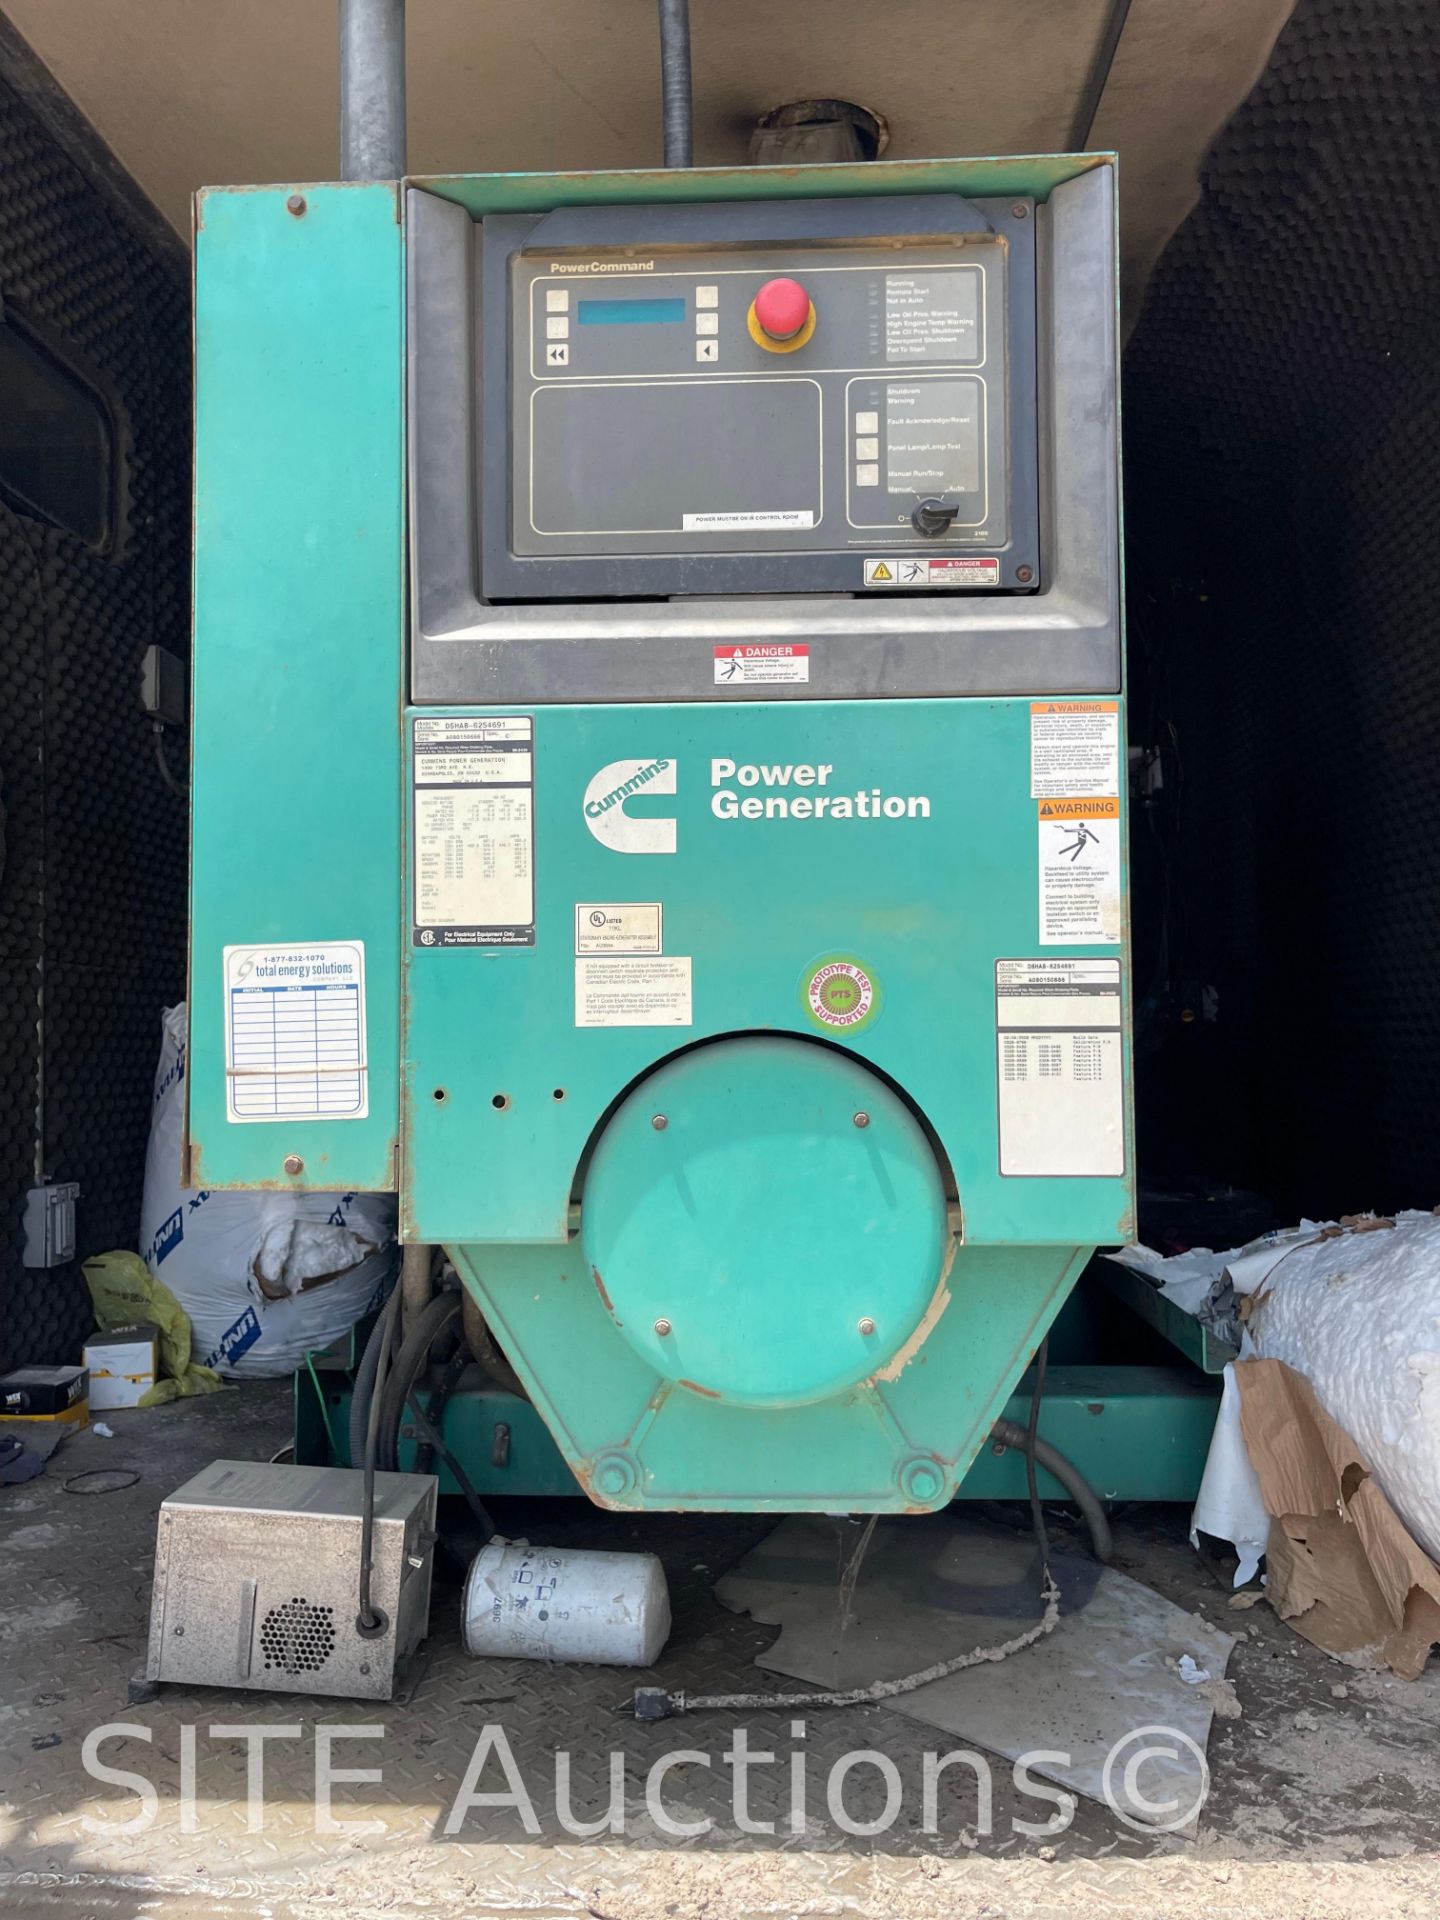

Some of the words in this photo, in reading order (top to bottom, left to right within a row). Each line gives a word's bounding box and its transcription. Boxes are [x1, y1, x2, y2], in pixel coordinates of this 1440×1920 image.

[551, 261, 654, 272] PowerCommand
[746, 647, 792, 656] DANGER
[711, 759, 832, 787] Power
[585, 758, 669, 819] Cummins
[711, 789, 931, 819] Generation
[1054, 803, 1114, 813] WARNING
[256, 965, 276, 976] total
[278, 964, 310, 978] energy
[312, 962, 352, 975] solutions
[810, 964, 853, 996] PROTOTYPE
[855, 970, 871, 992] TEST
[831, 990, 851, 998] PTS
[815, 1003, 868, 1025] SUPPORTED
[492, 1597, 502, 1622] 3697
